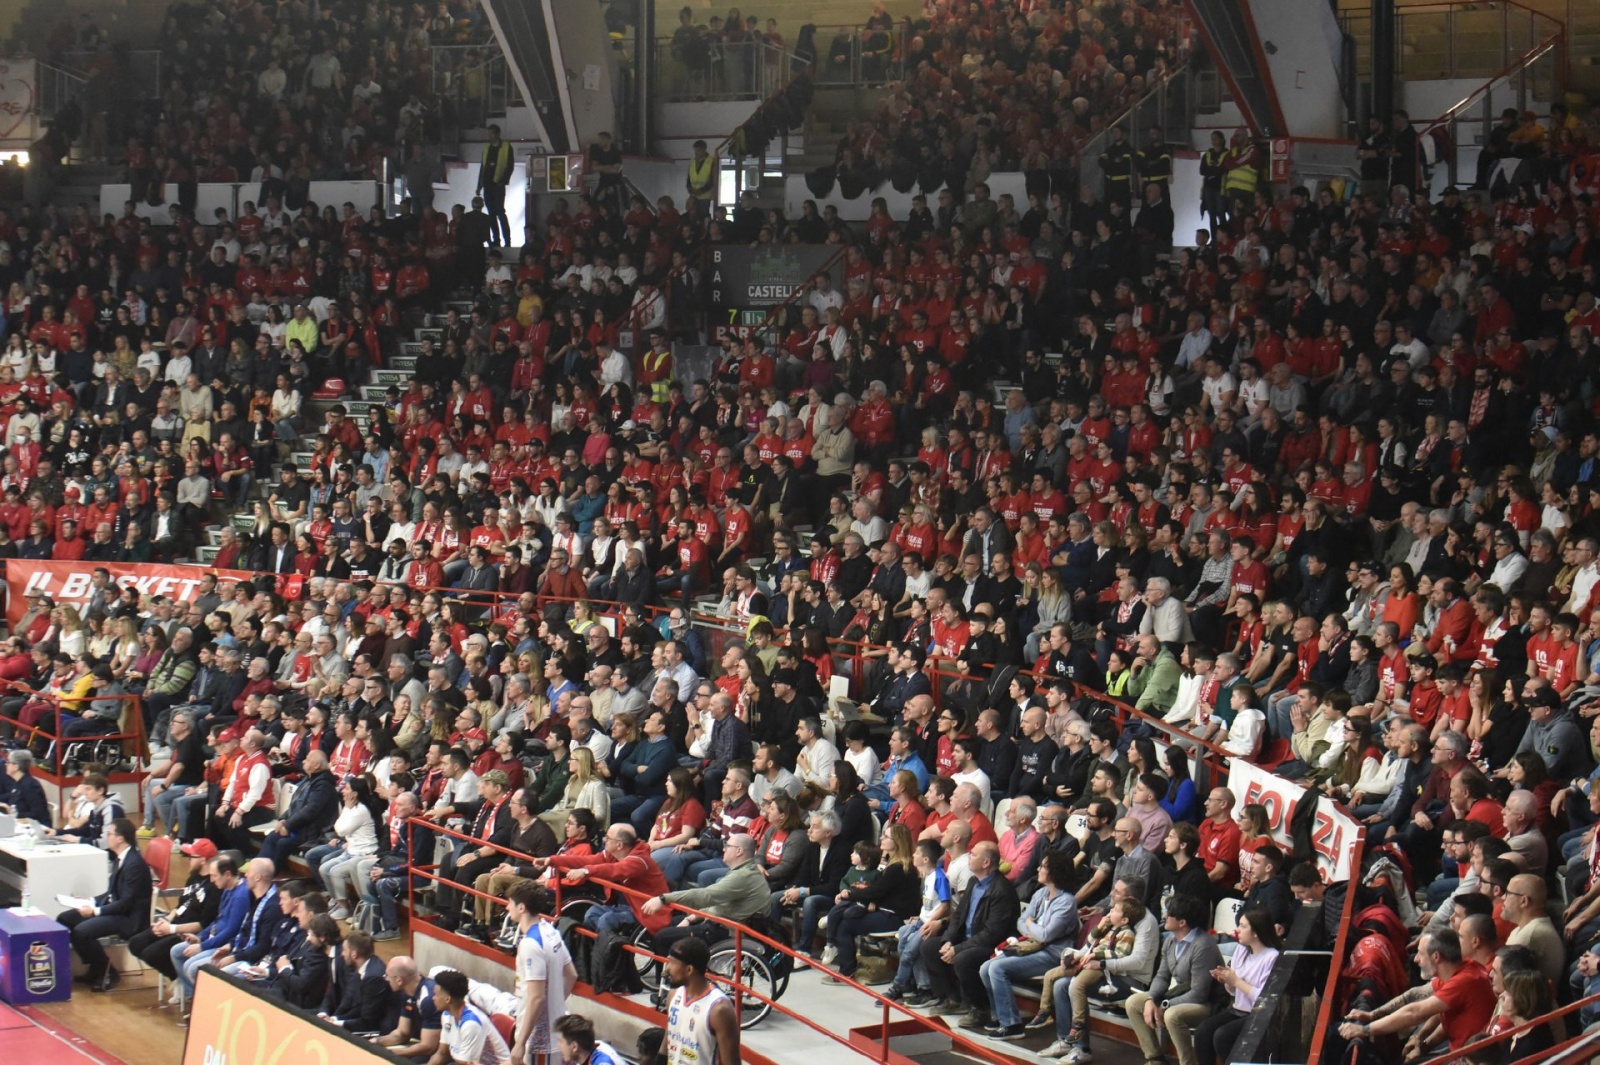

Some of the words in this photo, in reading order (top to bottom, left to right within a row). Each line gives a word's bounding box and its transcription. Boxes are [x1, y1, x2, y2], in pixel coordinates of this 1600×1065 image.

[728, 309, 737, 325] 7
[379, 373, 398, 381] INTESA
[235, 519, 254, 527] INTESA
[476, 535, 490, 544] 10
[23, 571, 54, 597] IL
[58, 572, 201, 606] BSKET
[1535, 649, 1547, 664] 10
[1077, 818, 1087, 828] 34
[768, 839, 784, 856] 10
[30, 962, 51, 972] LBA
